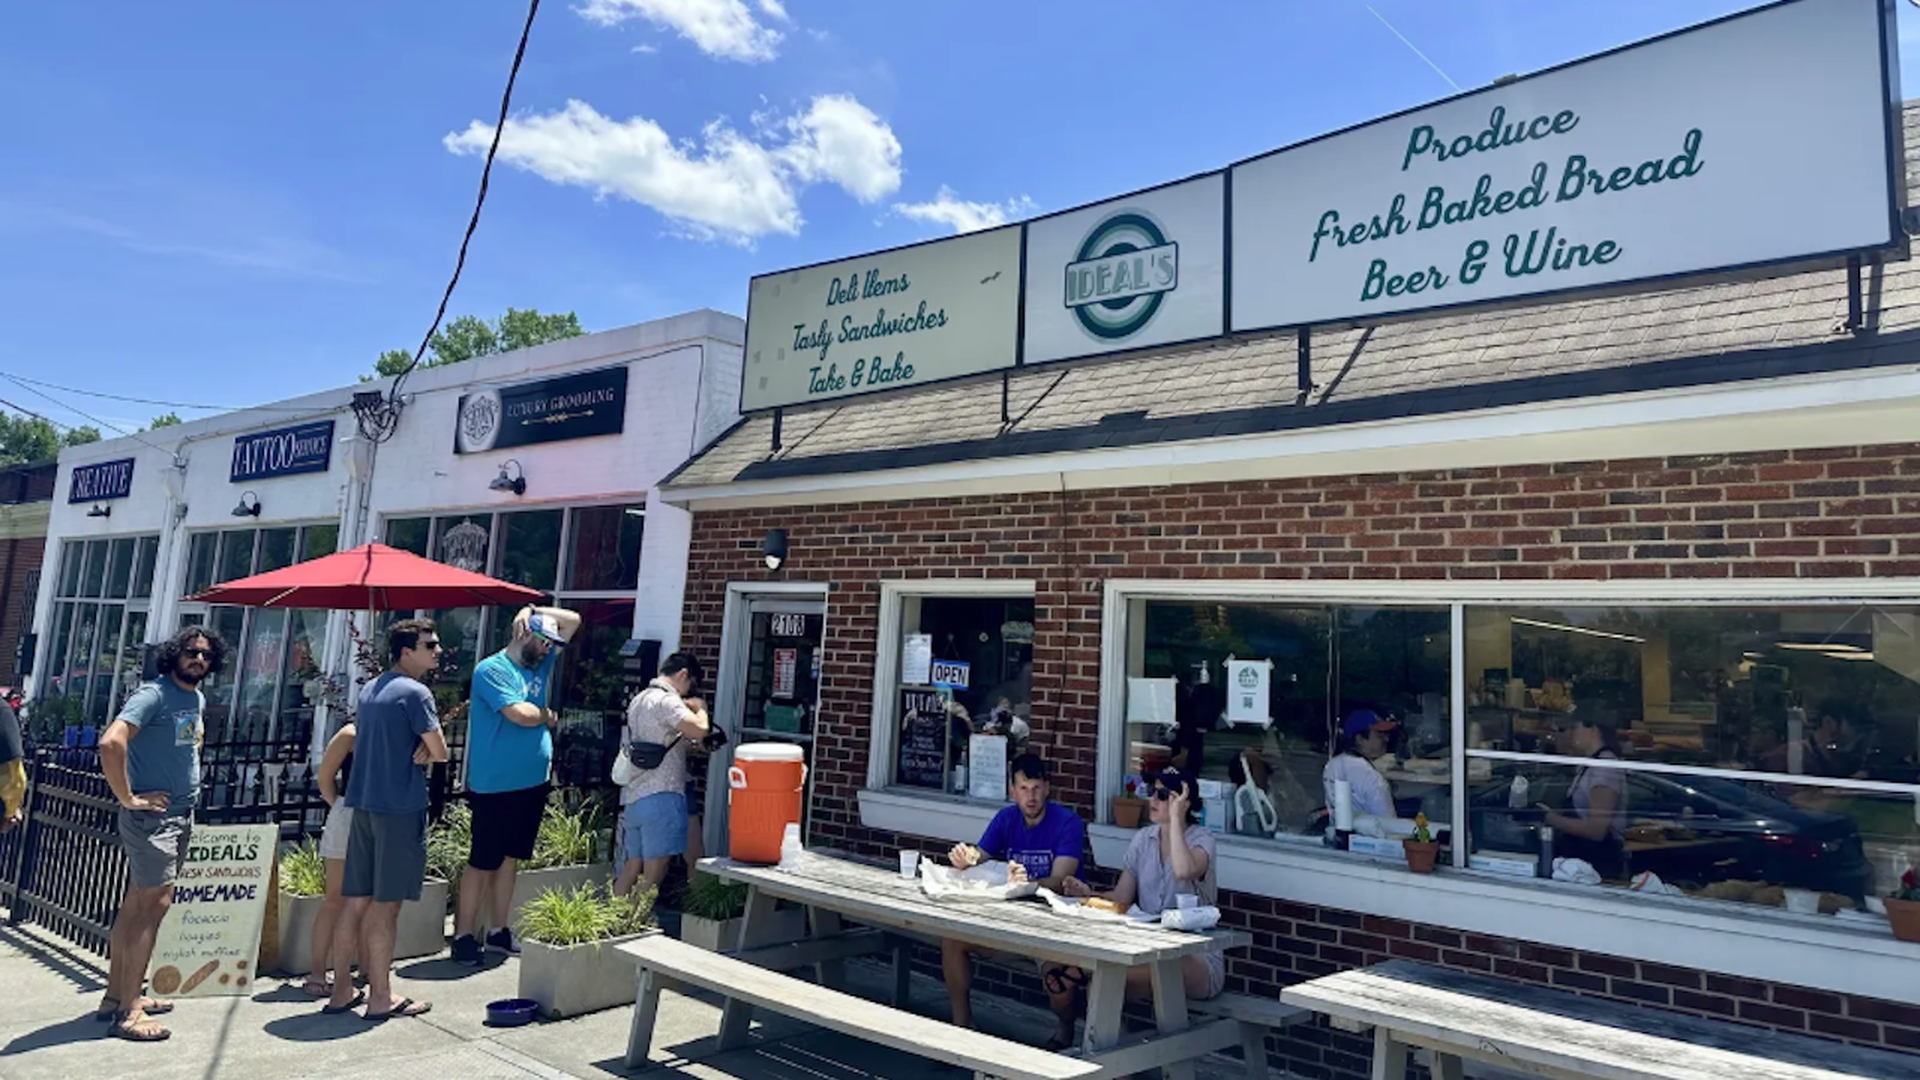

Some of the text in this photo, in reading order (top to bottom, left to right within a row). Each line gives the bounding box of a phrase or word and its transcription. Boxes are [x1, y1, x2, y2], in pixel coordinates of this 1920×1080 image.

[1401, 106, 1580, 171] Produce
[1417, 161, 1549, 231] Baked
[1556, 128, 1704, 202] Bread
[1068, 254, 1174, 302] IDEAL'S
[1361, 226, 1623, 301] Beer & Wine
[826, 268, 911, 306] Deli Items
[793, 300, 948, 361] Tasty Sandwiches
[809, 351, 915, 394] Take & Bake
[551, 388, 614, 410] GROOMING
[234, 433, 295, 476] TATTOO
[935, 665, 967, 685] OPEN
[190, 829, 238, 844] elcome
[171, 884, 257, 904] HOMEMADE
